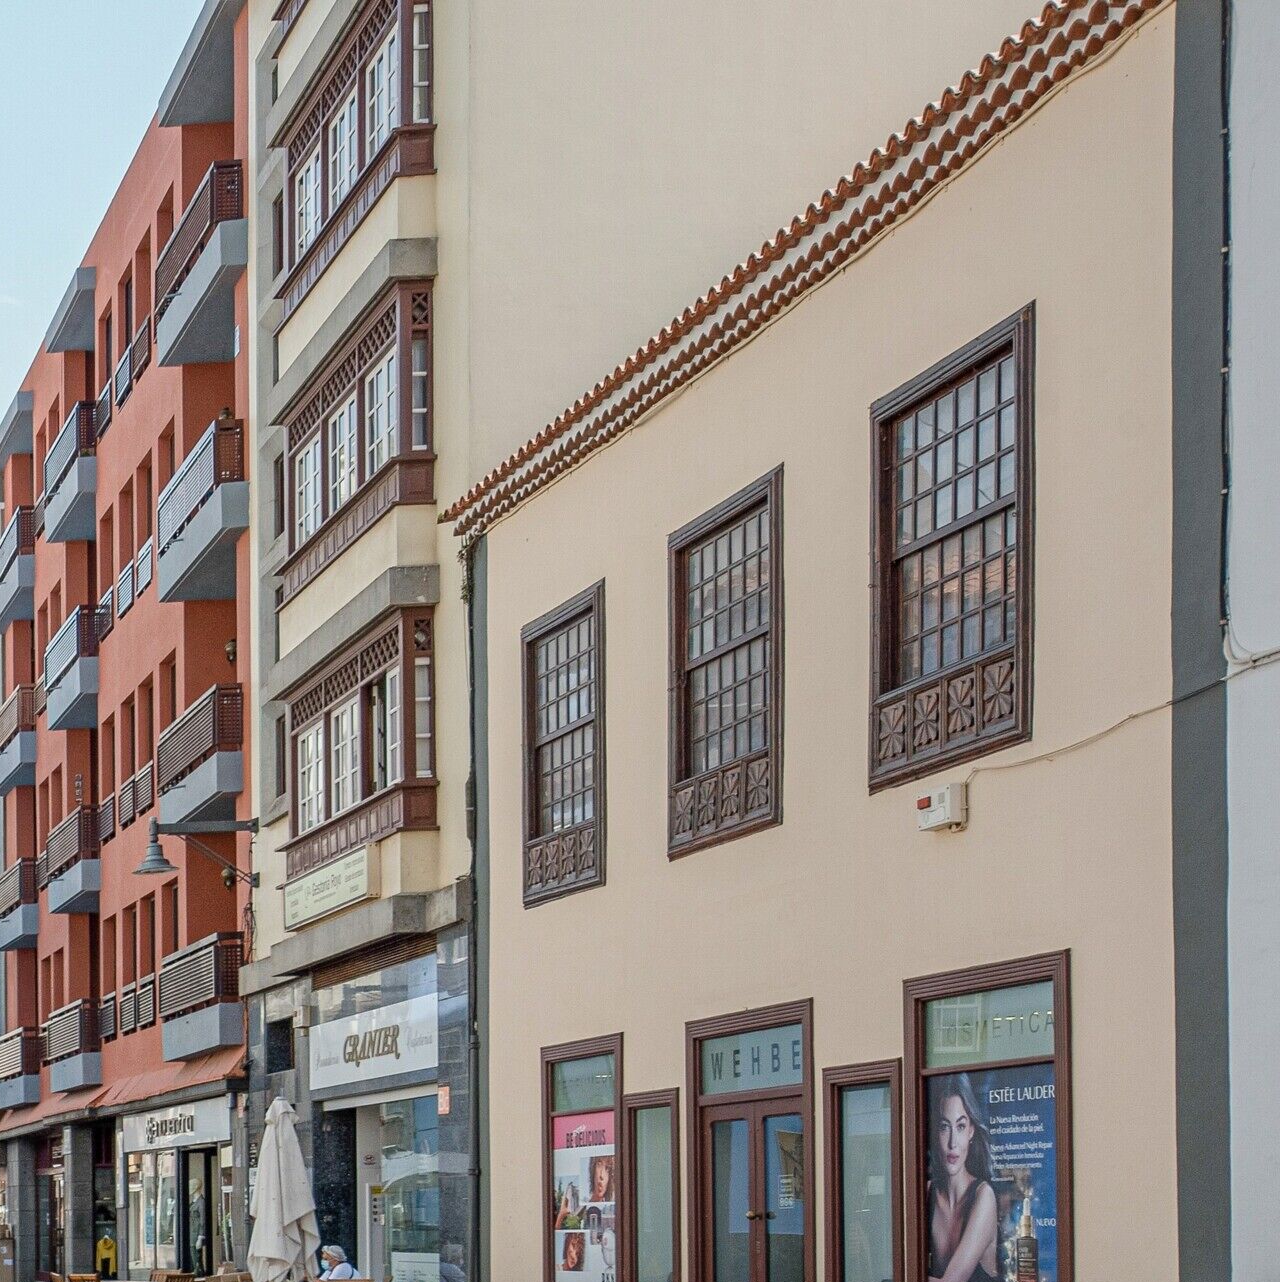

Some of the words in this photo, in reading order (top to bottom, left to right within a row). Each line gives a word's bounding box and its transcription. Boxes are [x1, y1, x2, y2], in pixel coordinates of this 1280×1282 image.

[343, 1024, 401, 1068] GRANIER
[711, 1040, 800, 1080] WEHBE
[1017, 1084, 1056, 1101] LAUDER
[601, 1272, 615, 1282] DKN
